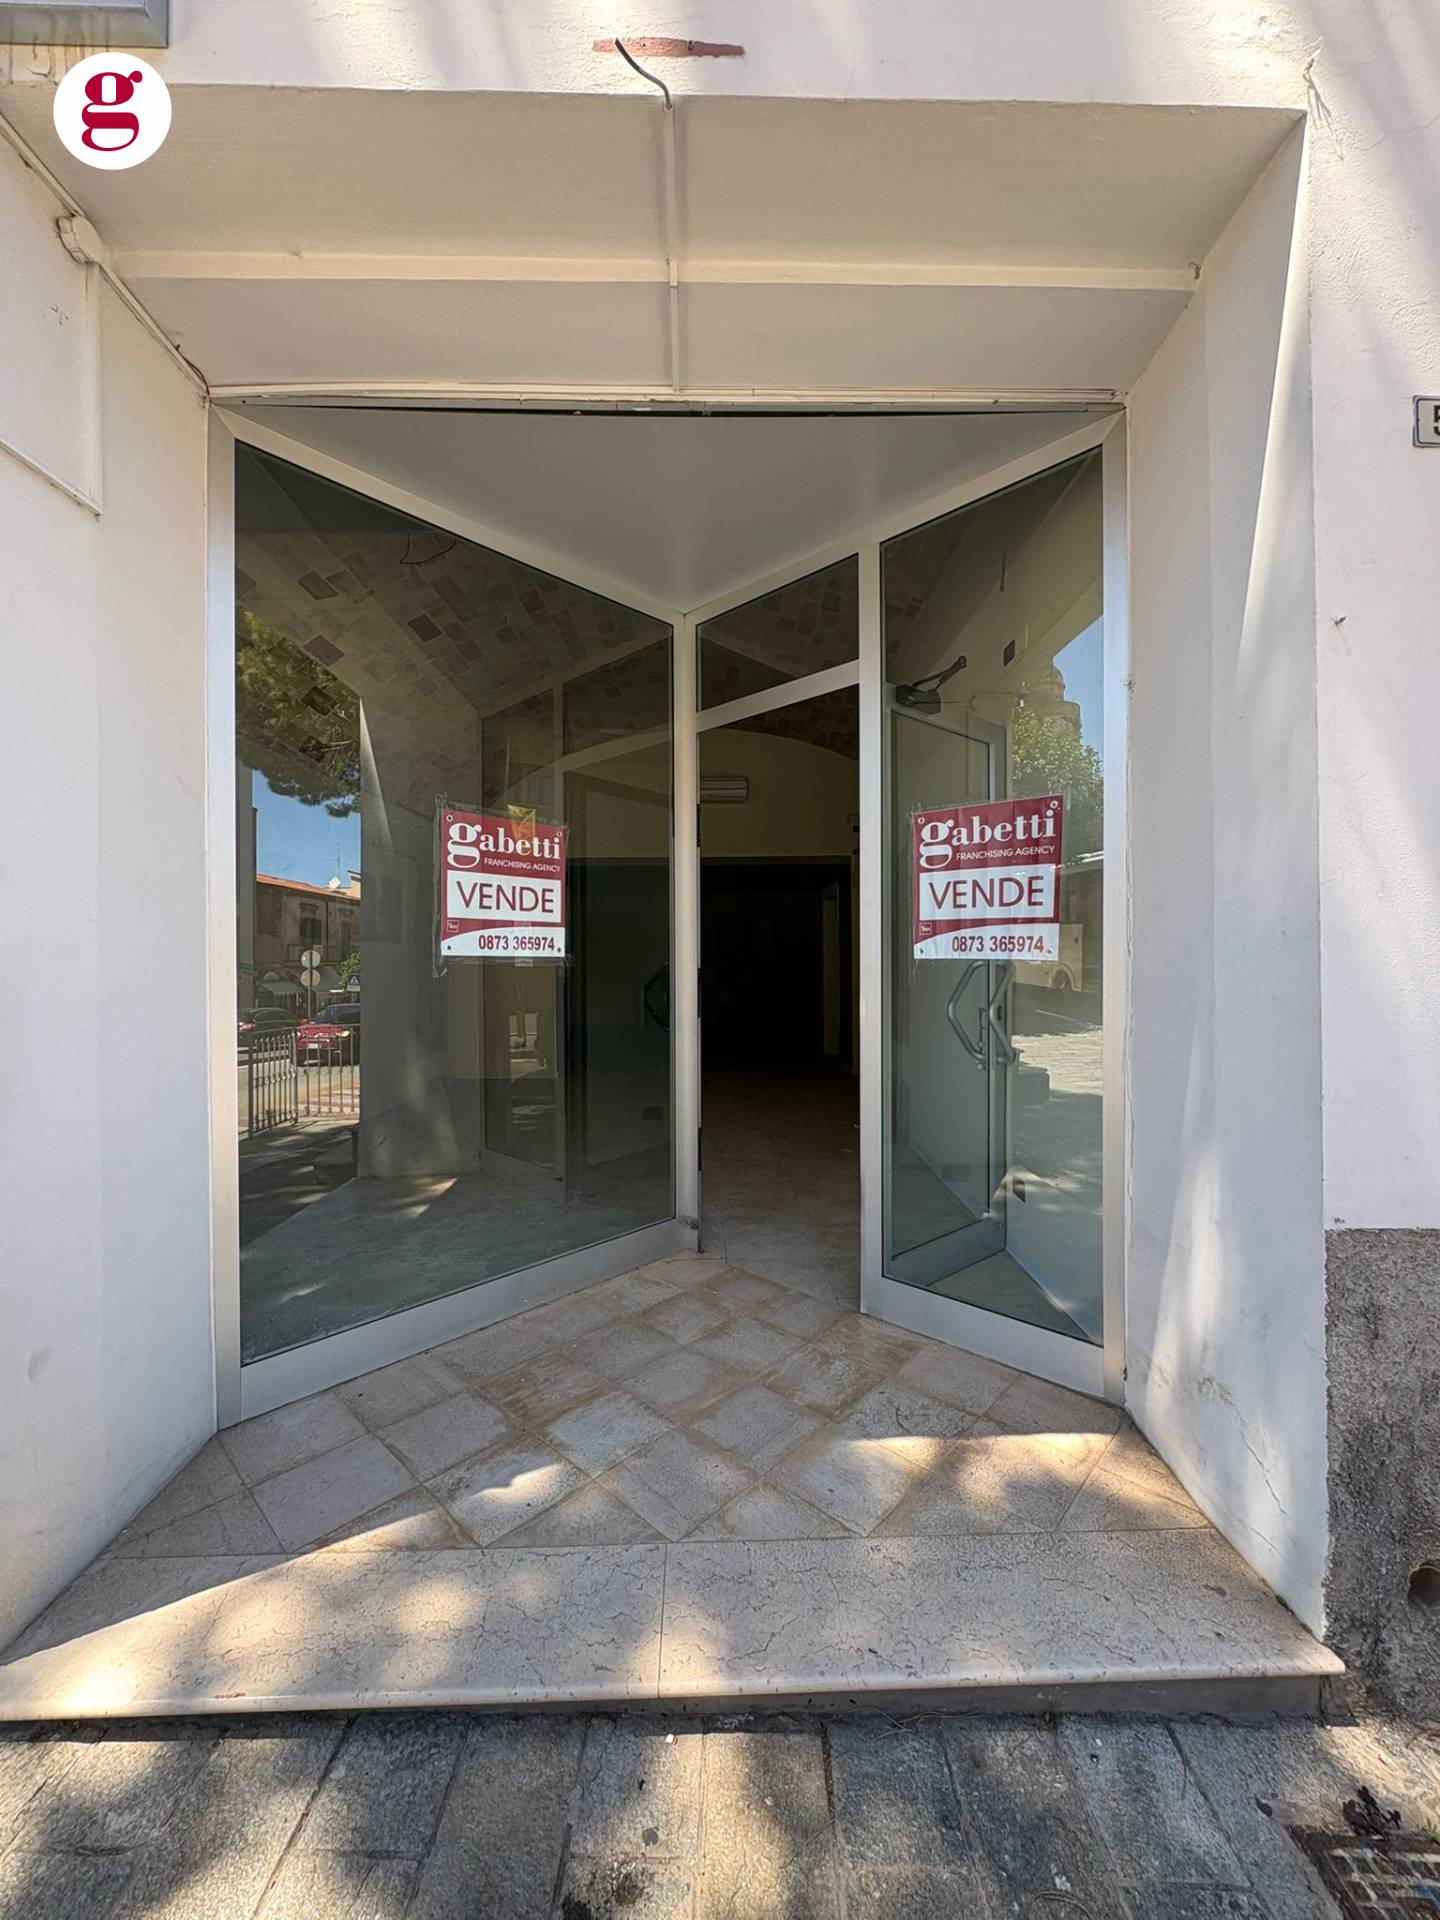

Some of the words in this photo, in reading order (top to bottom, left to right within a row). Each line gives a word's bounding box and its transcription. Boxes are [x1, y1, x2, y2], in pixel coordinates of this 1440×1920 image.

[447, 822, 561, 868] gabetti
[919, 809, 1057, 869] gabetti
[484, 857, 532, 870] FRANCHISING
[532, 861, 561, 872] AGENCY
[956, 849, 1013, 861] FRANCHISING
[1014, 845, 1055, 857] AGENCY
[456, 880, 554, 913] VENDE
[928, 875, 1044, 910] VENDE
[478, 934, 509, 950] 0873
[513, 936, 555, 951] 365974
[952, 936, 984, 952] 0873
[989, 936, 1044, 952] 365974
